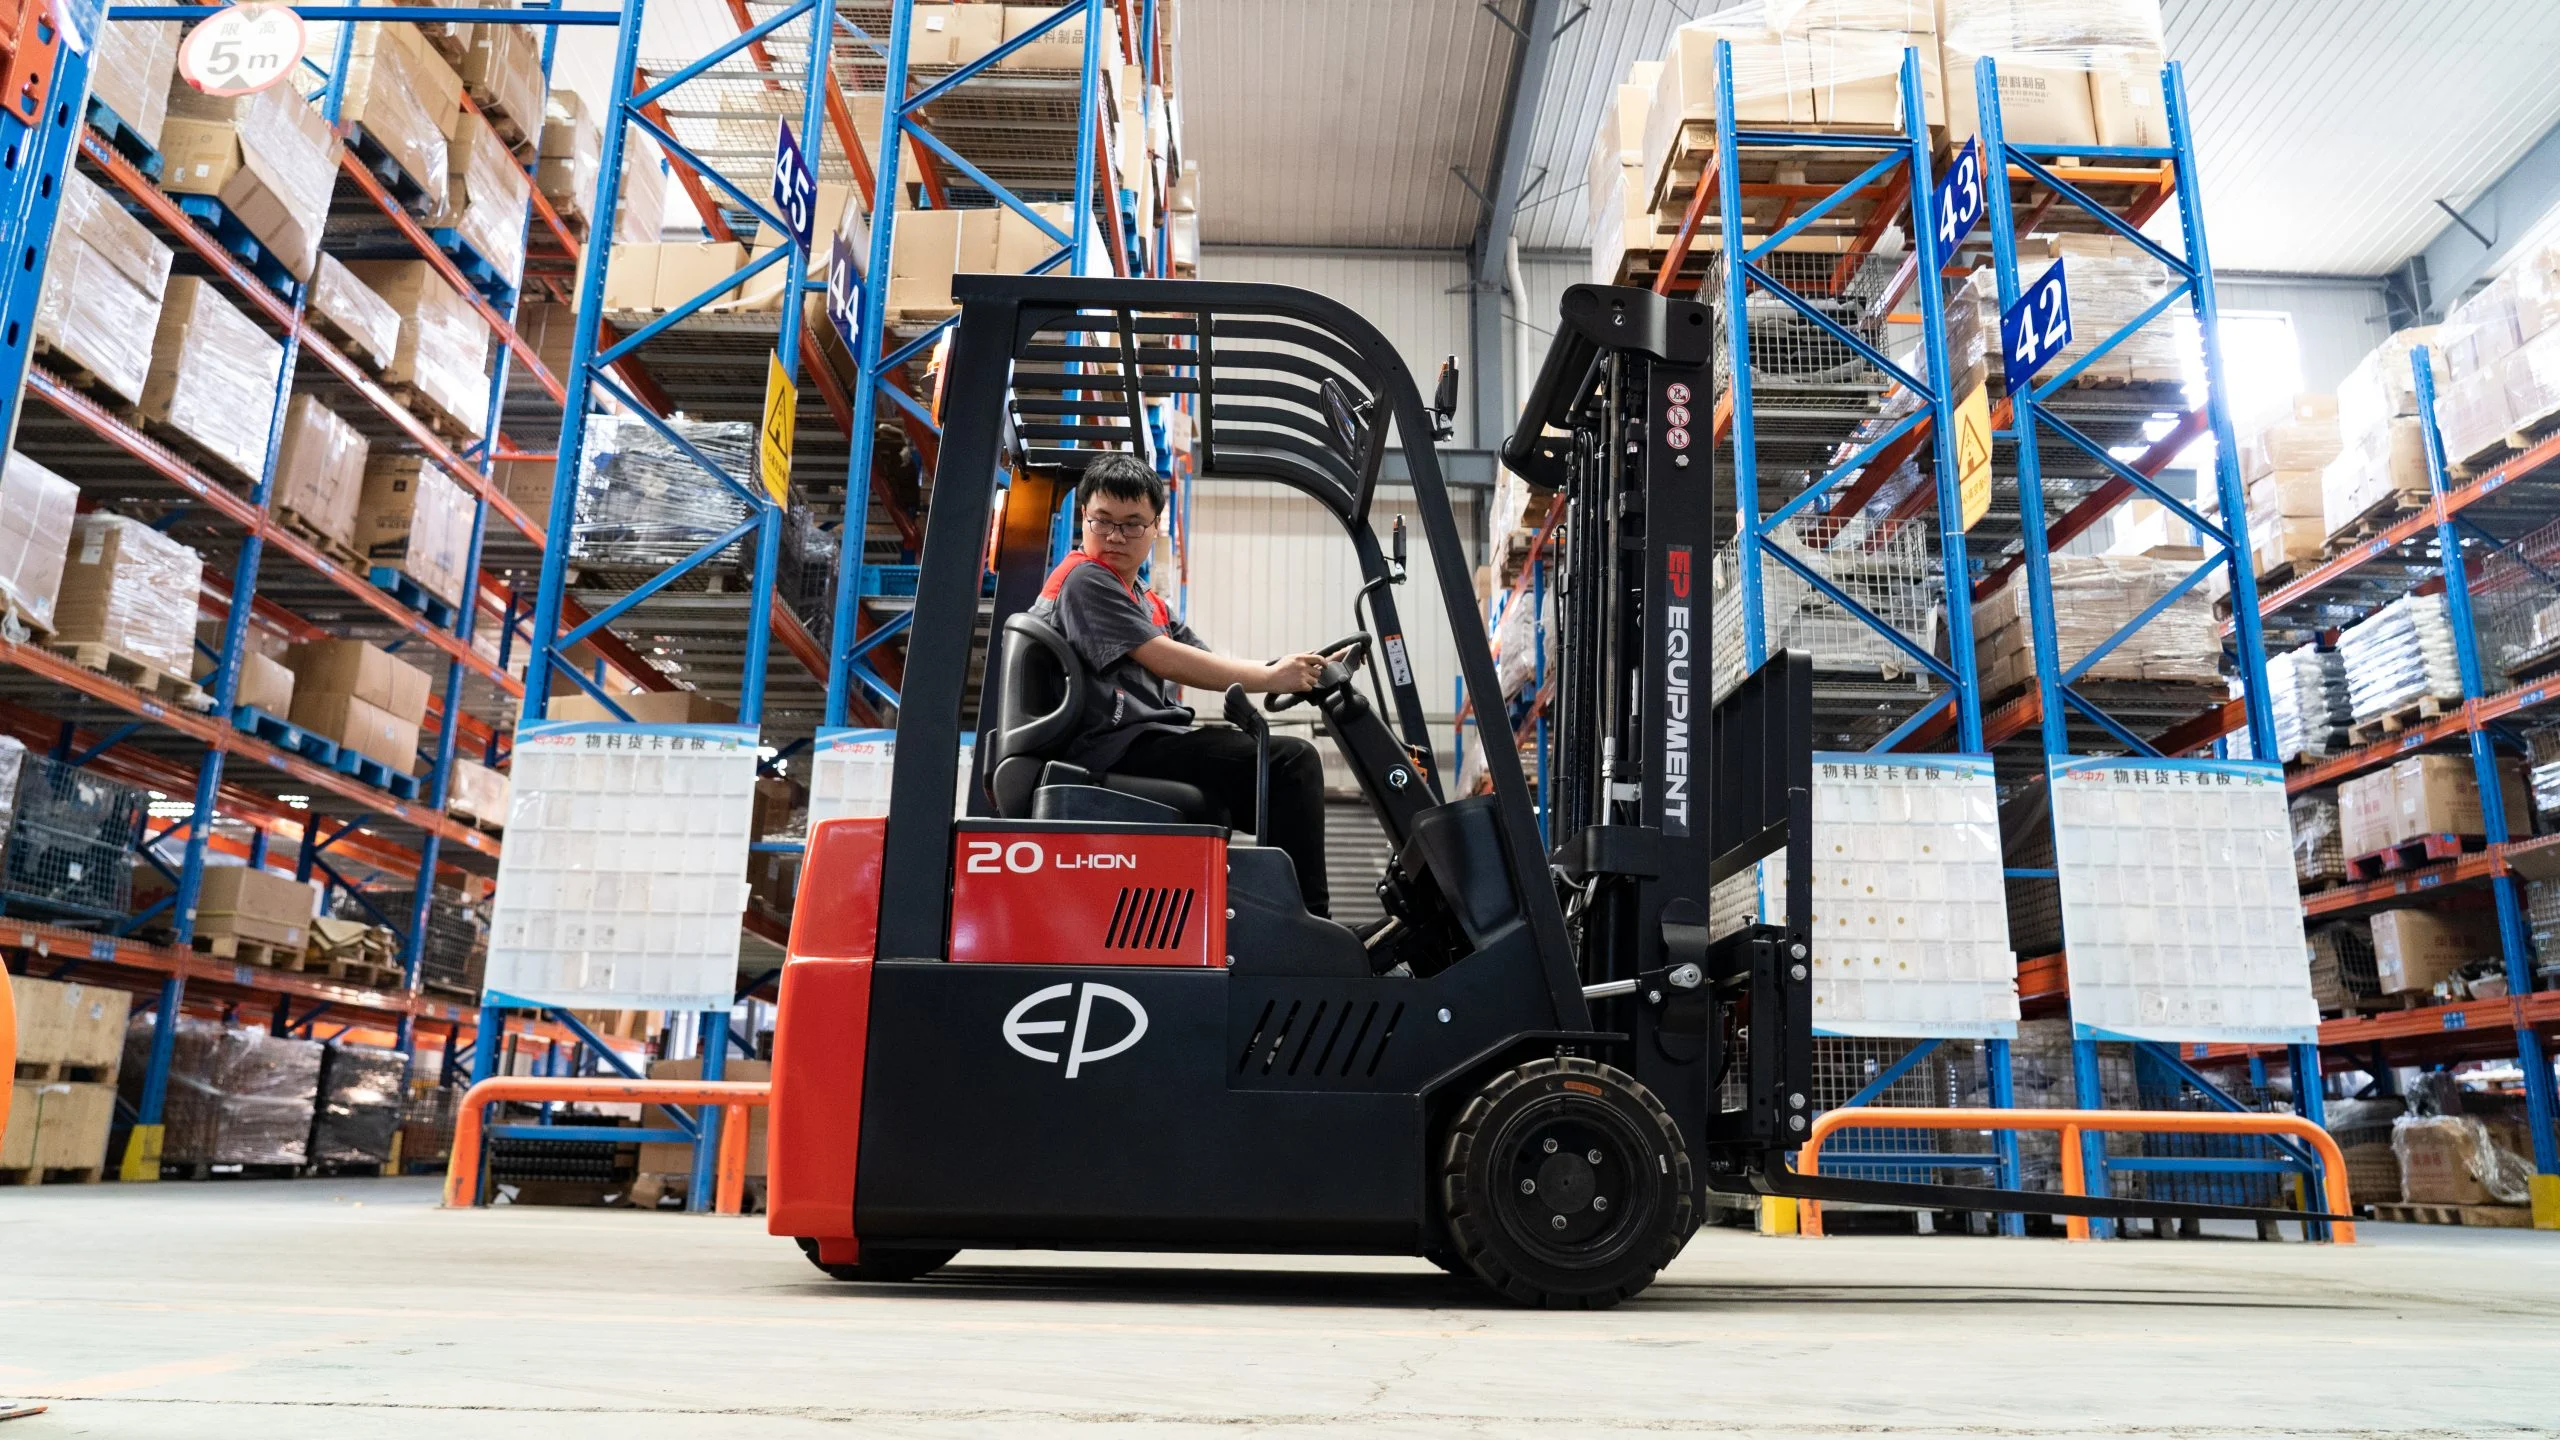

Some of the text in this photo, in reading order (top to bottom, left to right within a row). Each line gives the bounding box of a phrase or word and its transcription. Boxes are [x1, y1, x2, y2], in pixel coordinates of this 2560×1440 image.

[1032, 28, 1084, 45] 料制品
[777, 147, 809, 233] 45
[1940, 156, 1977, 243] 43
[831, 259, 859, 343] 44
[2015, 278, 2067, 364] 42
[1666, 551, 1690, 826] EP EQUIPMENT
[585, 733, 706, 751] 物料货卡看板
[1822, 763, 1942, 781] 物料货卡看板
[2113, 768, 2232, 786] 物料货卡看板
[967, 841, 1044, 873] 20
[1002, 982, 1149, 1078] EP
